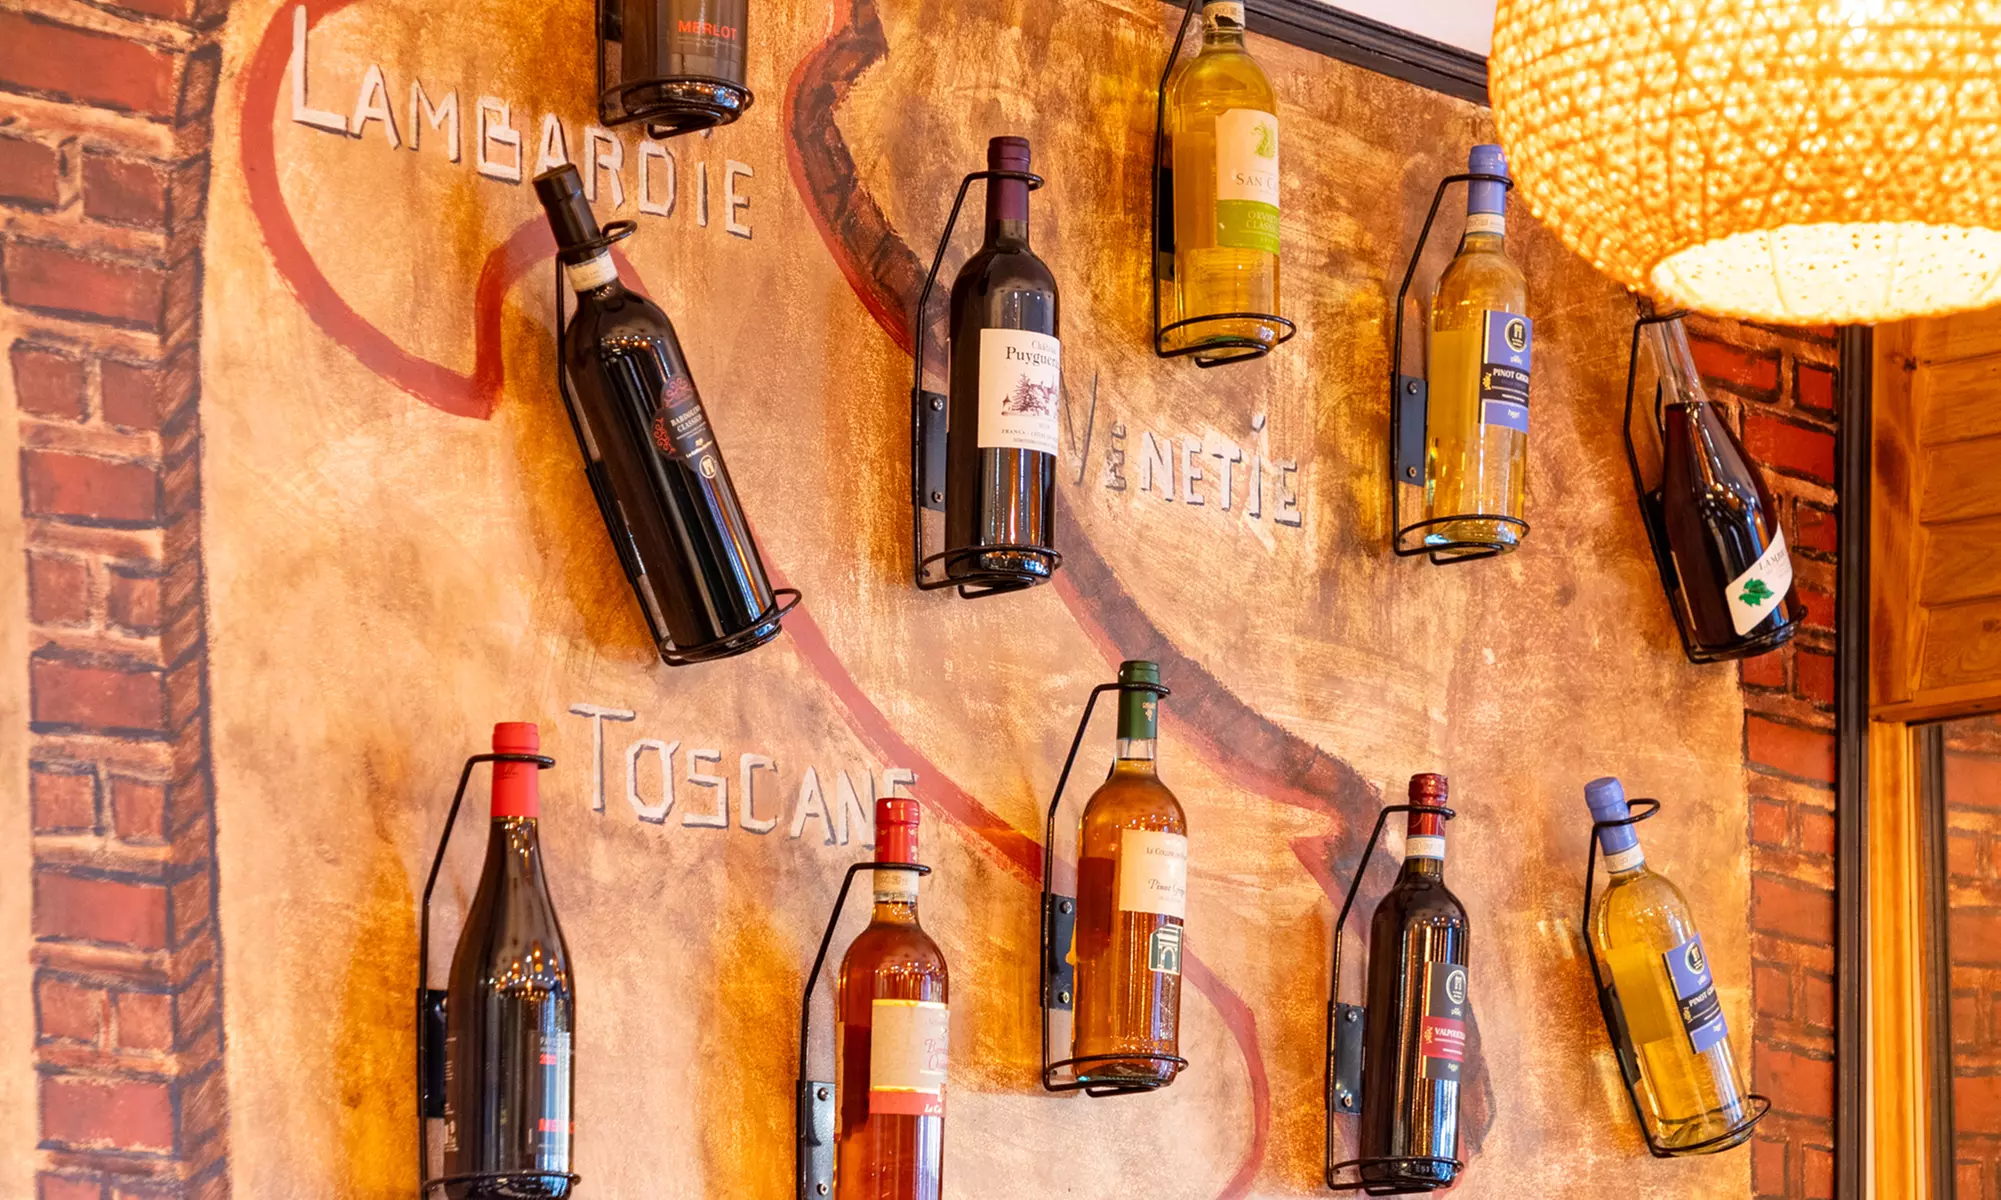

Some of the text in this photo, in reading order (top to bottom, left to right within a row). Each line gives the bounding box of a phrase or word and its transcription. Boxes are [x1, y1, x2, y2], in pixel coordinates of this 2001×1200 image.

[677, 19, 737, 40] MERLOT
[1236, 172, 1262, 187] SAN
[1493, 367, 1515, 380] PINOT
